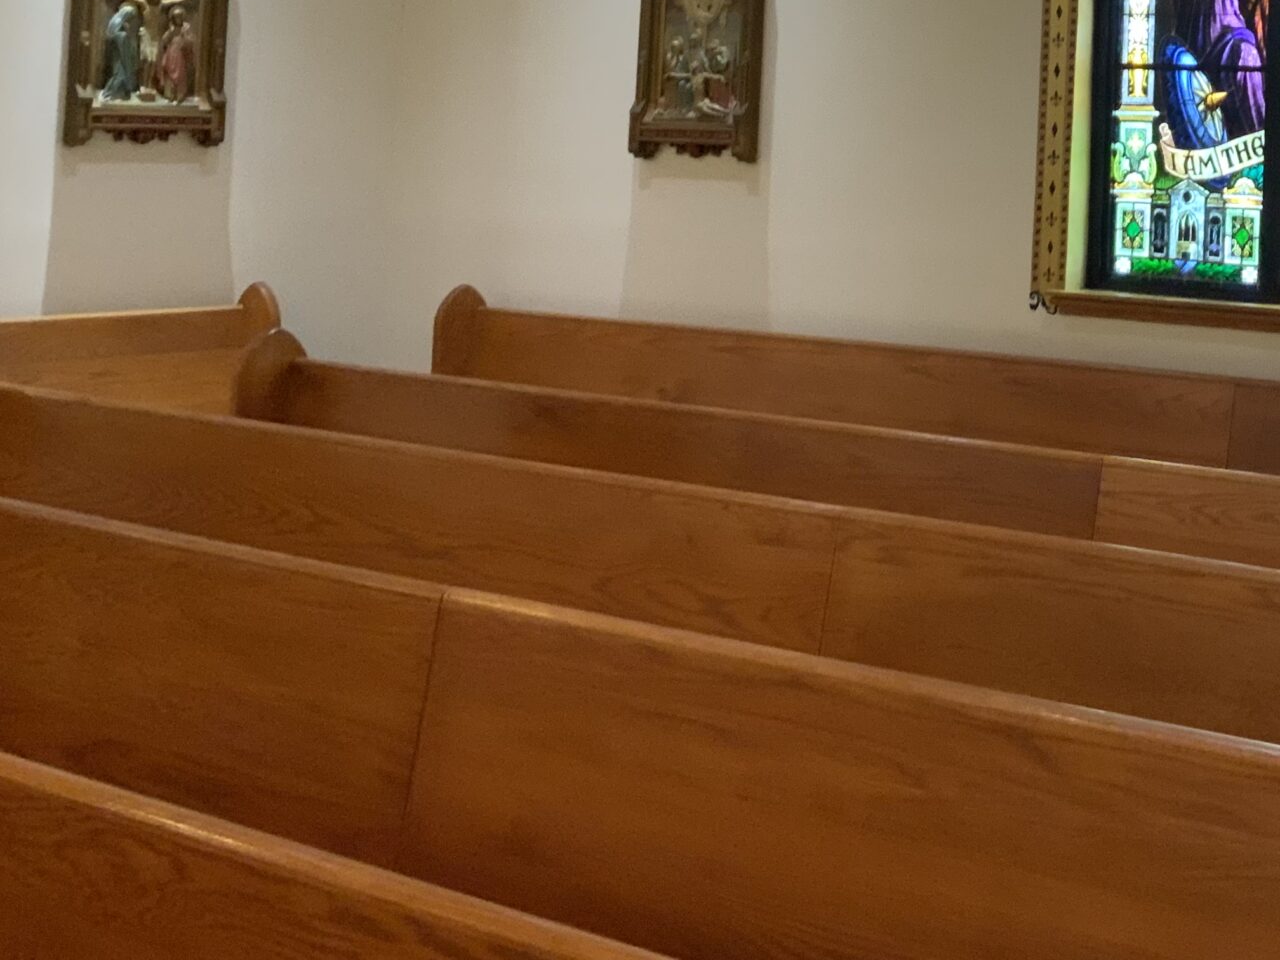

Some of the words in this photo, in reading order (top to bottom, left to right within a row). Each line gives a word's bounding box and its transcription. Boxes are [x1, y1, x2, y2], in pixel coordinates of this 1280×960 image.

[1169, 152, 1177, 172] I
[1183, 149, 1218, 176] AM
[1220, 135, 1265, 169] THE
